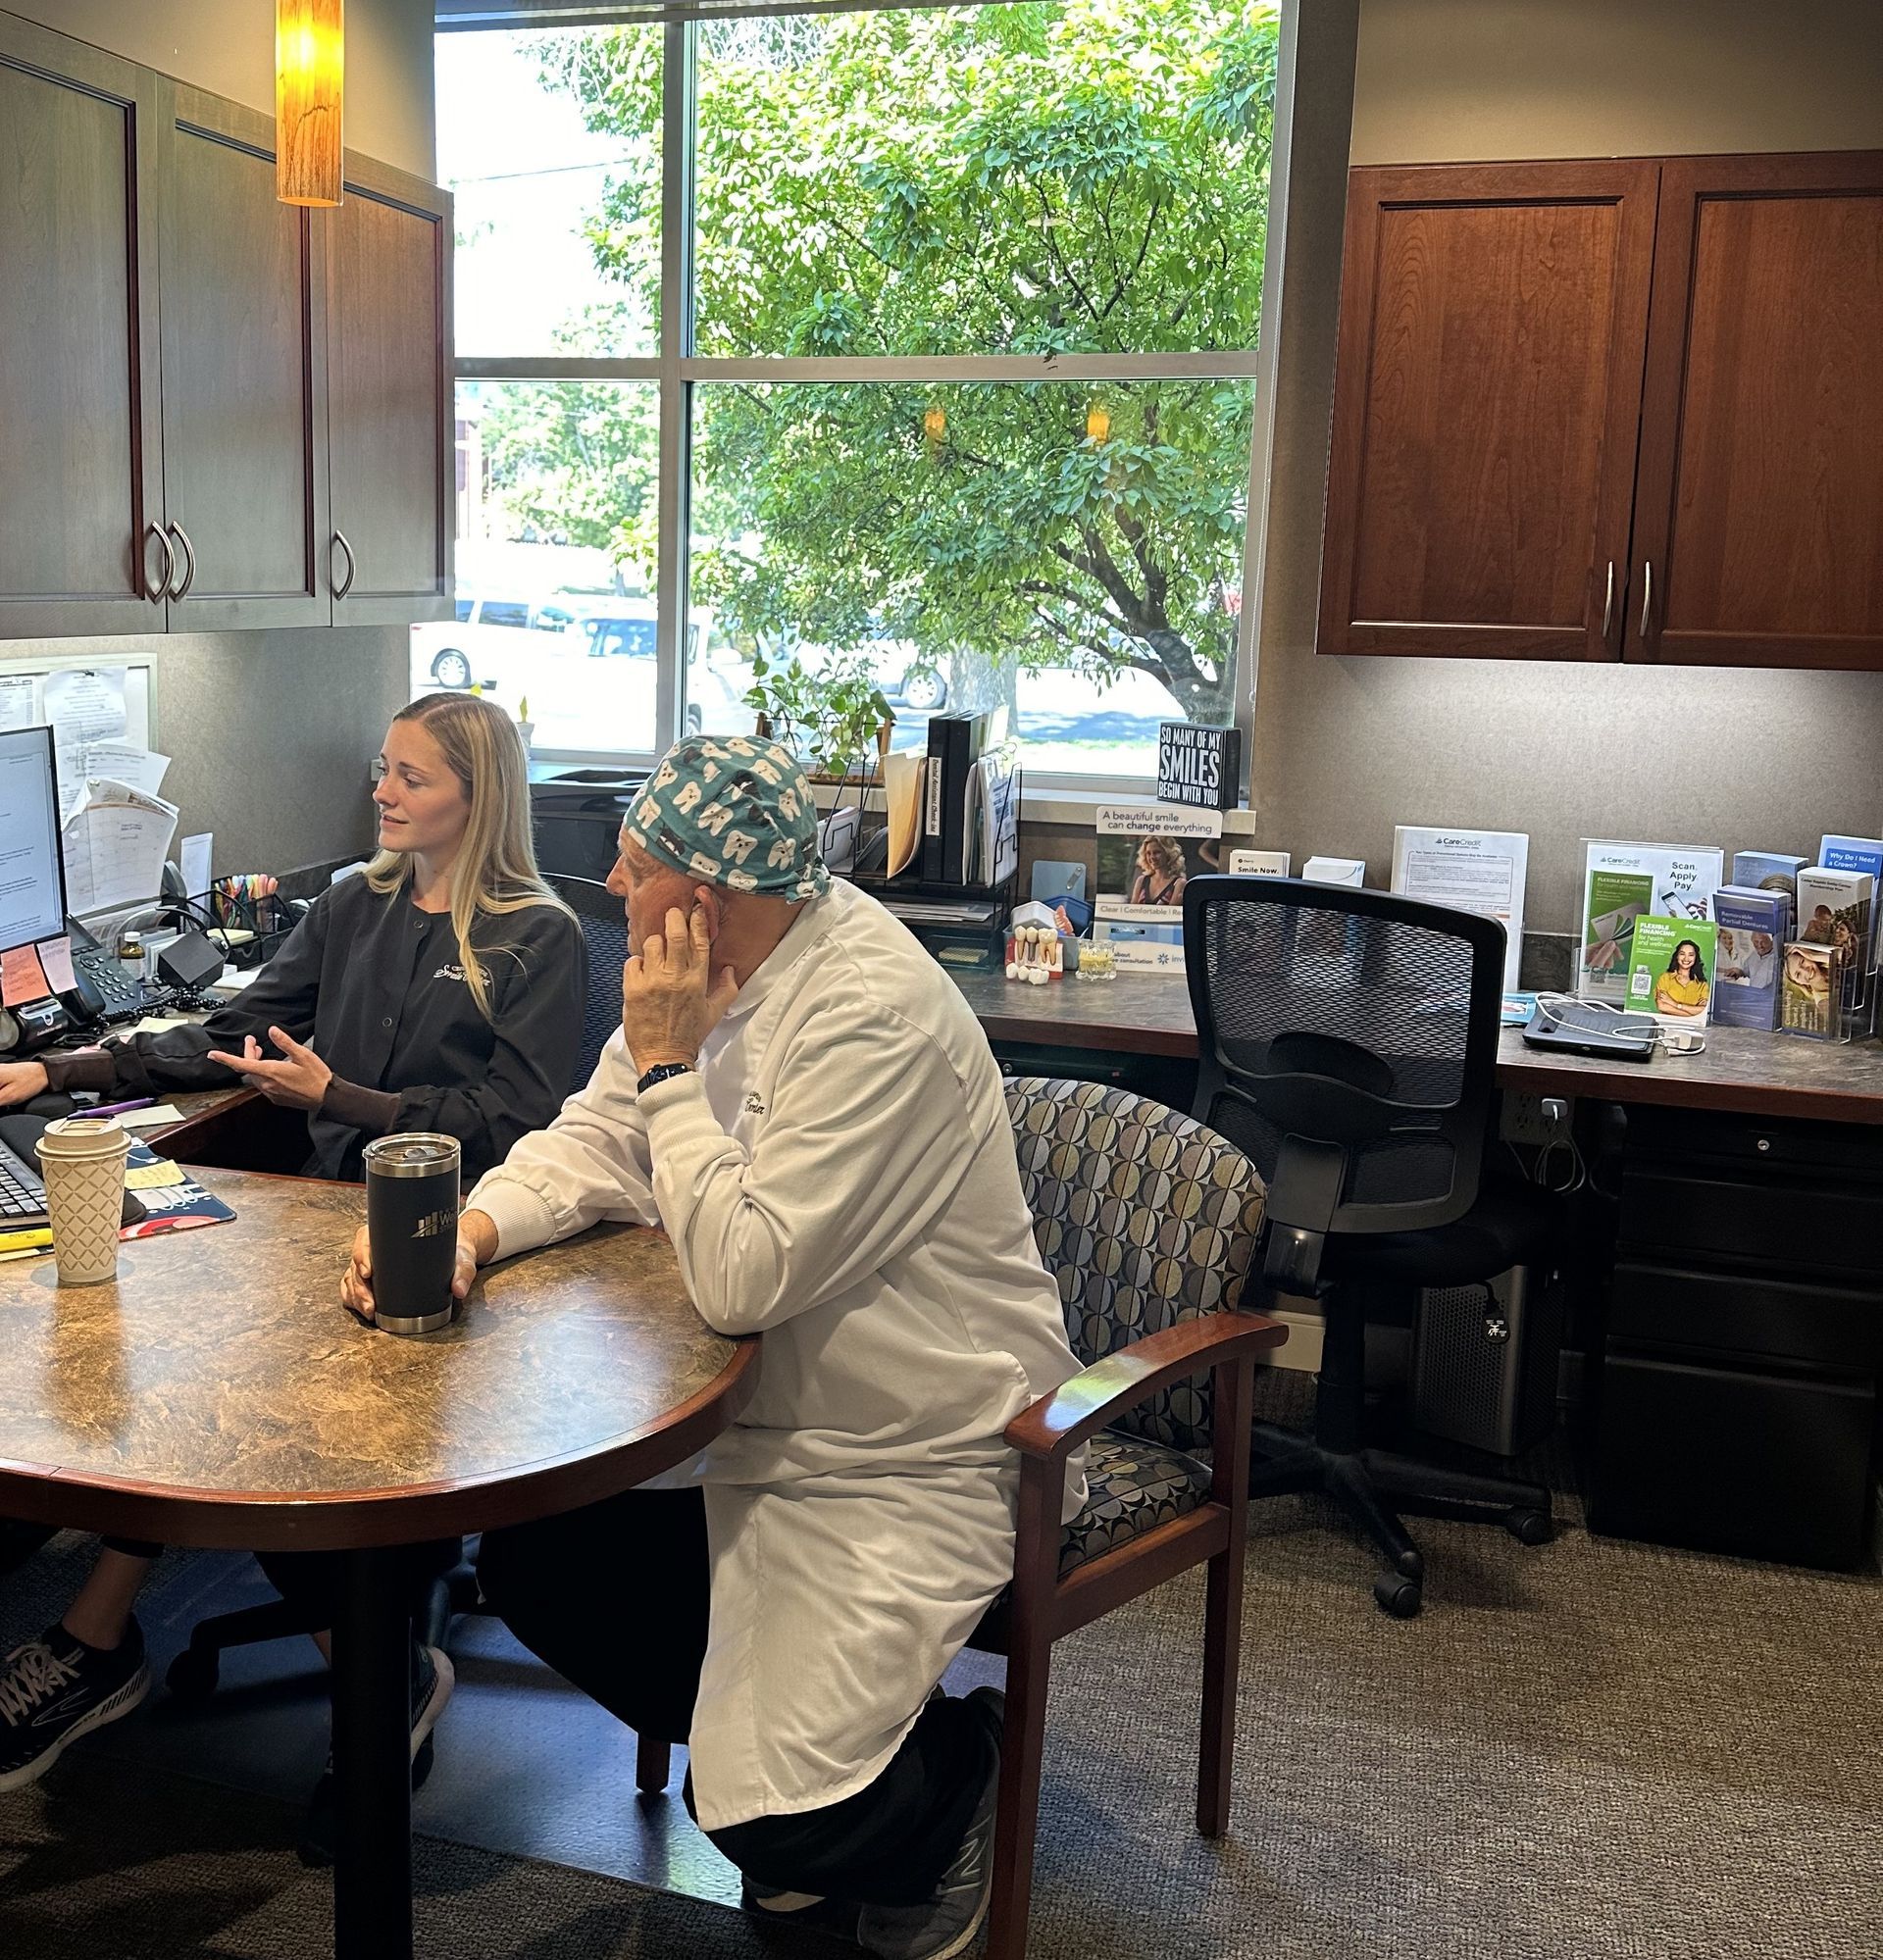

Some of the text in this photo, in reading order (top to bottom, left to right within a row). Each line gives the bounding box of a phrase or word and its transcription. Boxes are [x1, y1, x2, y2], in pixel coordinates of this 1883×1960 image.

[1160, 727, 1221, 750] SO MANY OF MY
[1159, 744, 1220, 788] SMILES
[1158, 780, 1218, 806] BEGIN WITH YOU
[1102, 811, 1179, 822] A beautiful smile
[1126, 822, 1160, 831] change
[1163, 823, 1212, 834] everything
[1124, 906, 1167, 915] Comfortable
